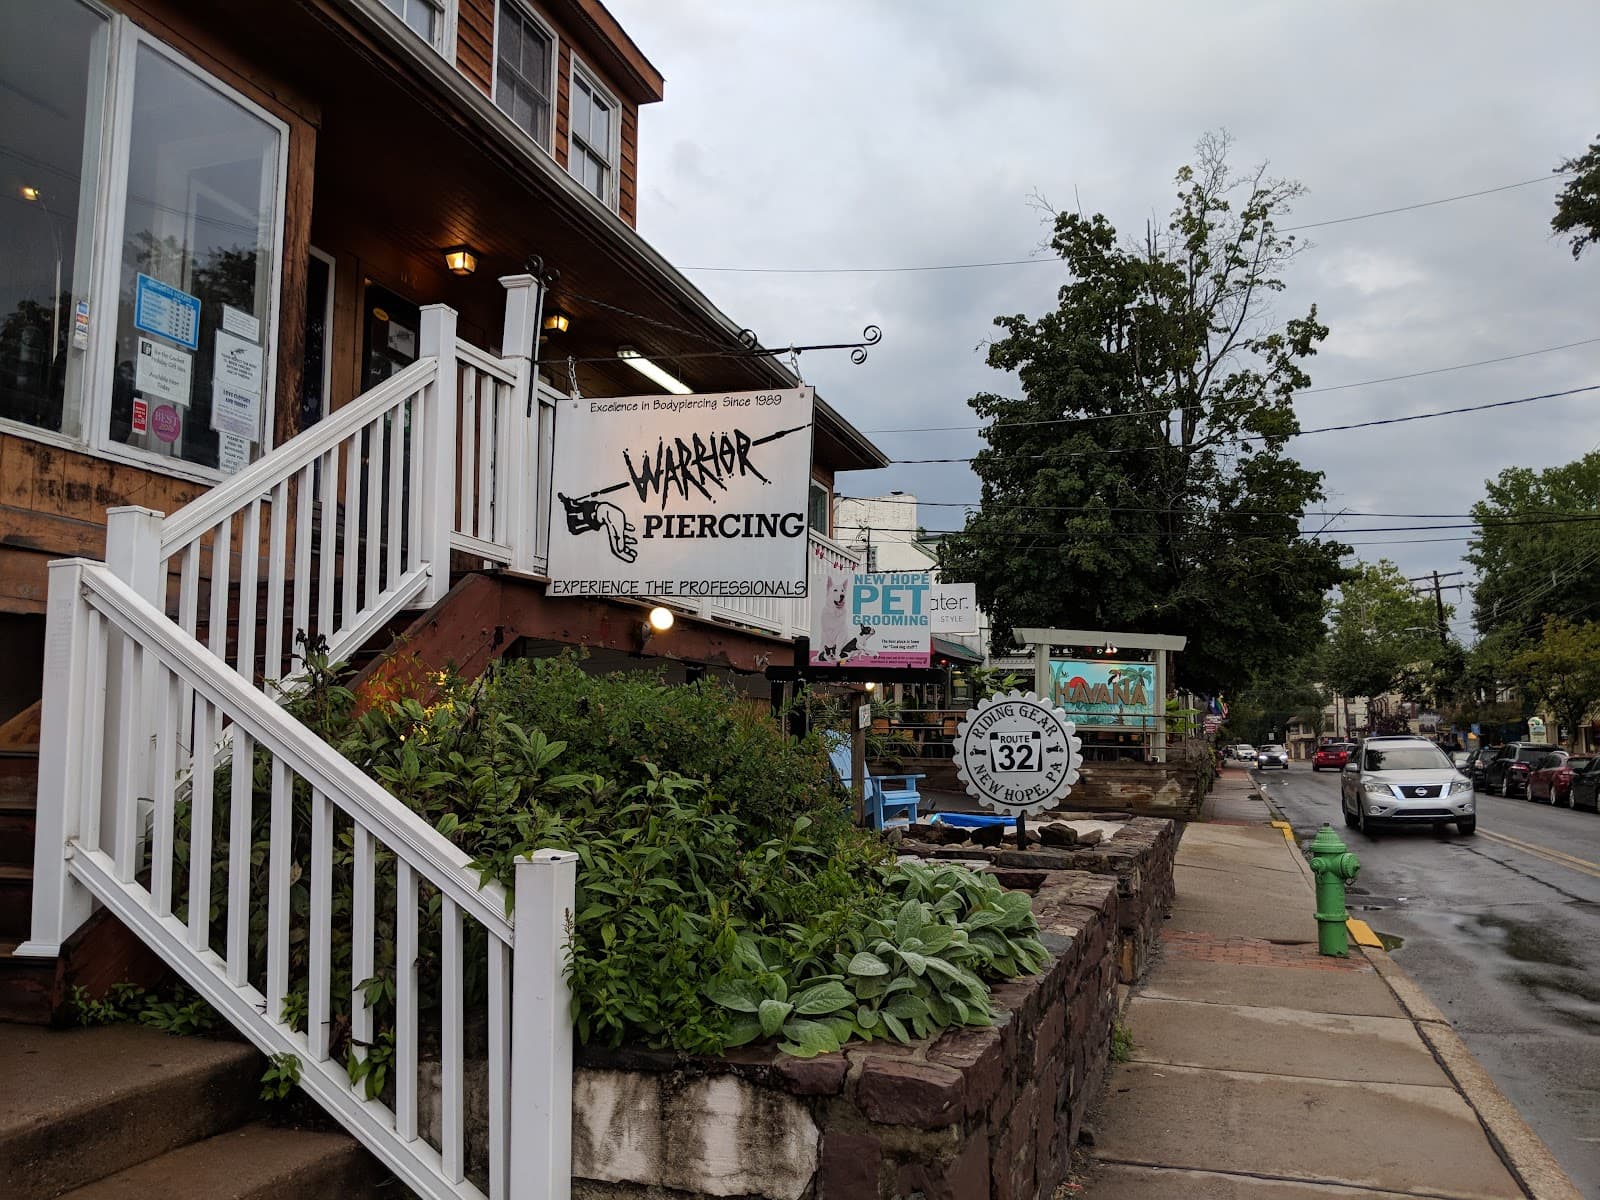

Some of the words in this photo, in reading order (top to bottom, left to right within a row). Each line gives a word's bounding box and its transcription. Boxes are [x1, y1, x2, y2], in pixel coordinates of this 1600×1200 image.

[590, 400, 638, 413] Excellence
[653, 398, 718, 413] Bodypiercing
[722, 396, 751, 408] Since
[755, 394, 782, 406] 1989
[623, 428, 772, 512] WARRIOR
[642, 512, 805, 539] PIERCING
[553, 579, 639, 594] EXPERIENCE
[645, 580, 673, 594] THE
[679, 579, 806, 595] PROFESSIONALS
[854, 574, 885, 585] NEW
[890, 573, 930, 585] HOPE
[852, 584, 930, 615] PET
[852, 614, 929, 626] GROOMING
[940, 615, 963, 623] STYLE
[1055, 680, 1148, 706] HAVANA
[972, 704, 1014, 740] RIDING
[1018, 704, 1058, 738] GEAR
[1000, 735, 1030, 744] ROUTE
[998, 744, 1034, 771] 32
[974, 764, 1003, 795] NEW
[1005, 784, 1050, 802] HOPE,
[1045, 761, 1062, 784] PA
